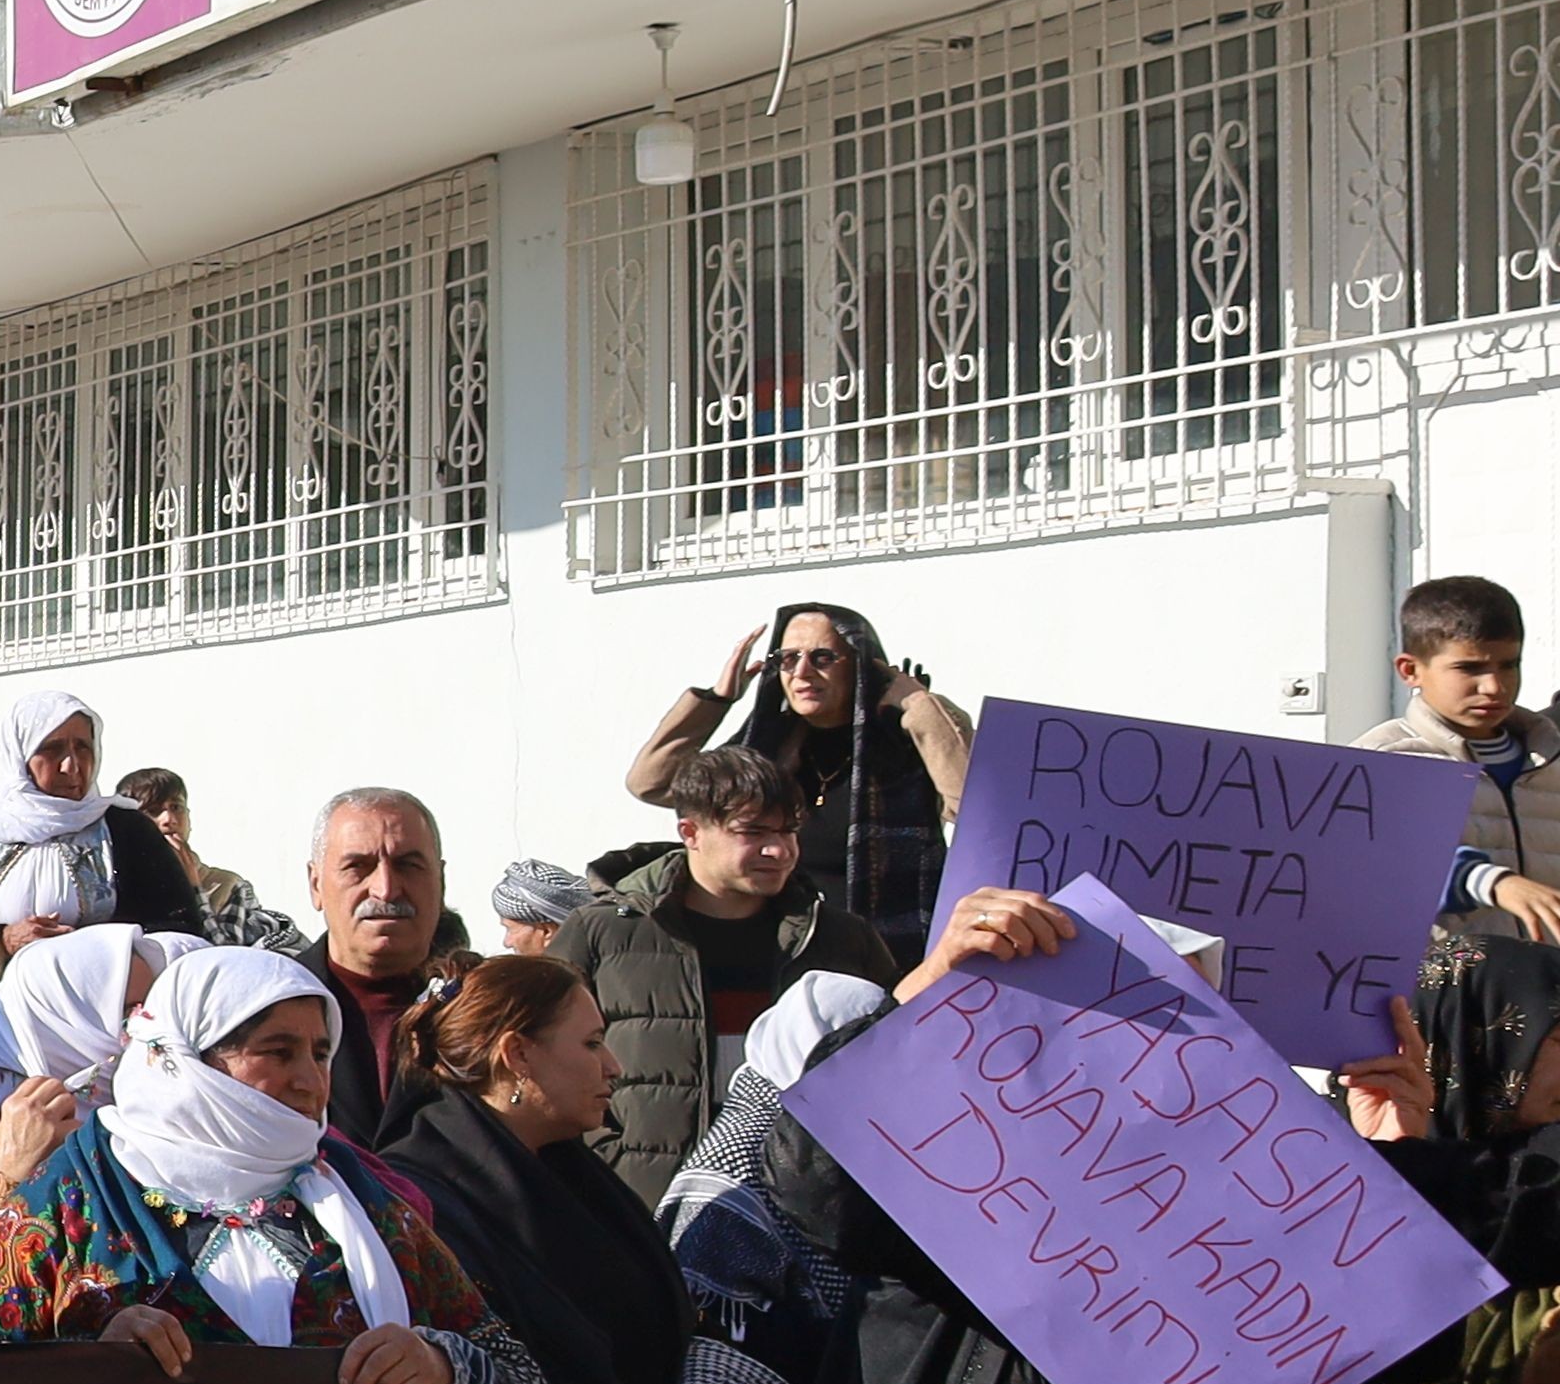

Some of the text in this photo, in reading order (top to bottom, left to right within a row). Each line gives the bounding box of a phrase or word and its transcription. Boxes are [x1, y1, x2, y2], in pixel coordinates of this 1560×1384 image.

[1029, 717, 1375, 841] ROJAVA
[1317, 950, 1401, 1017] YE
[915, 974, 1188, 1233] ROJAVA
